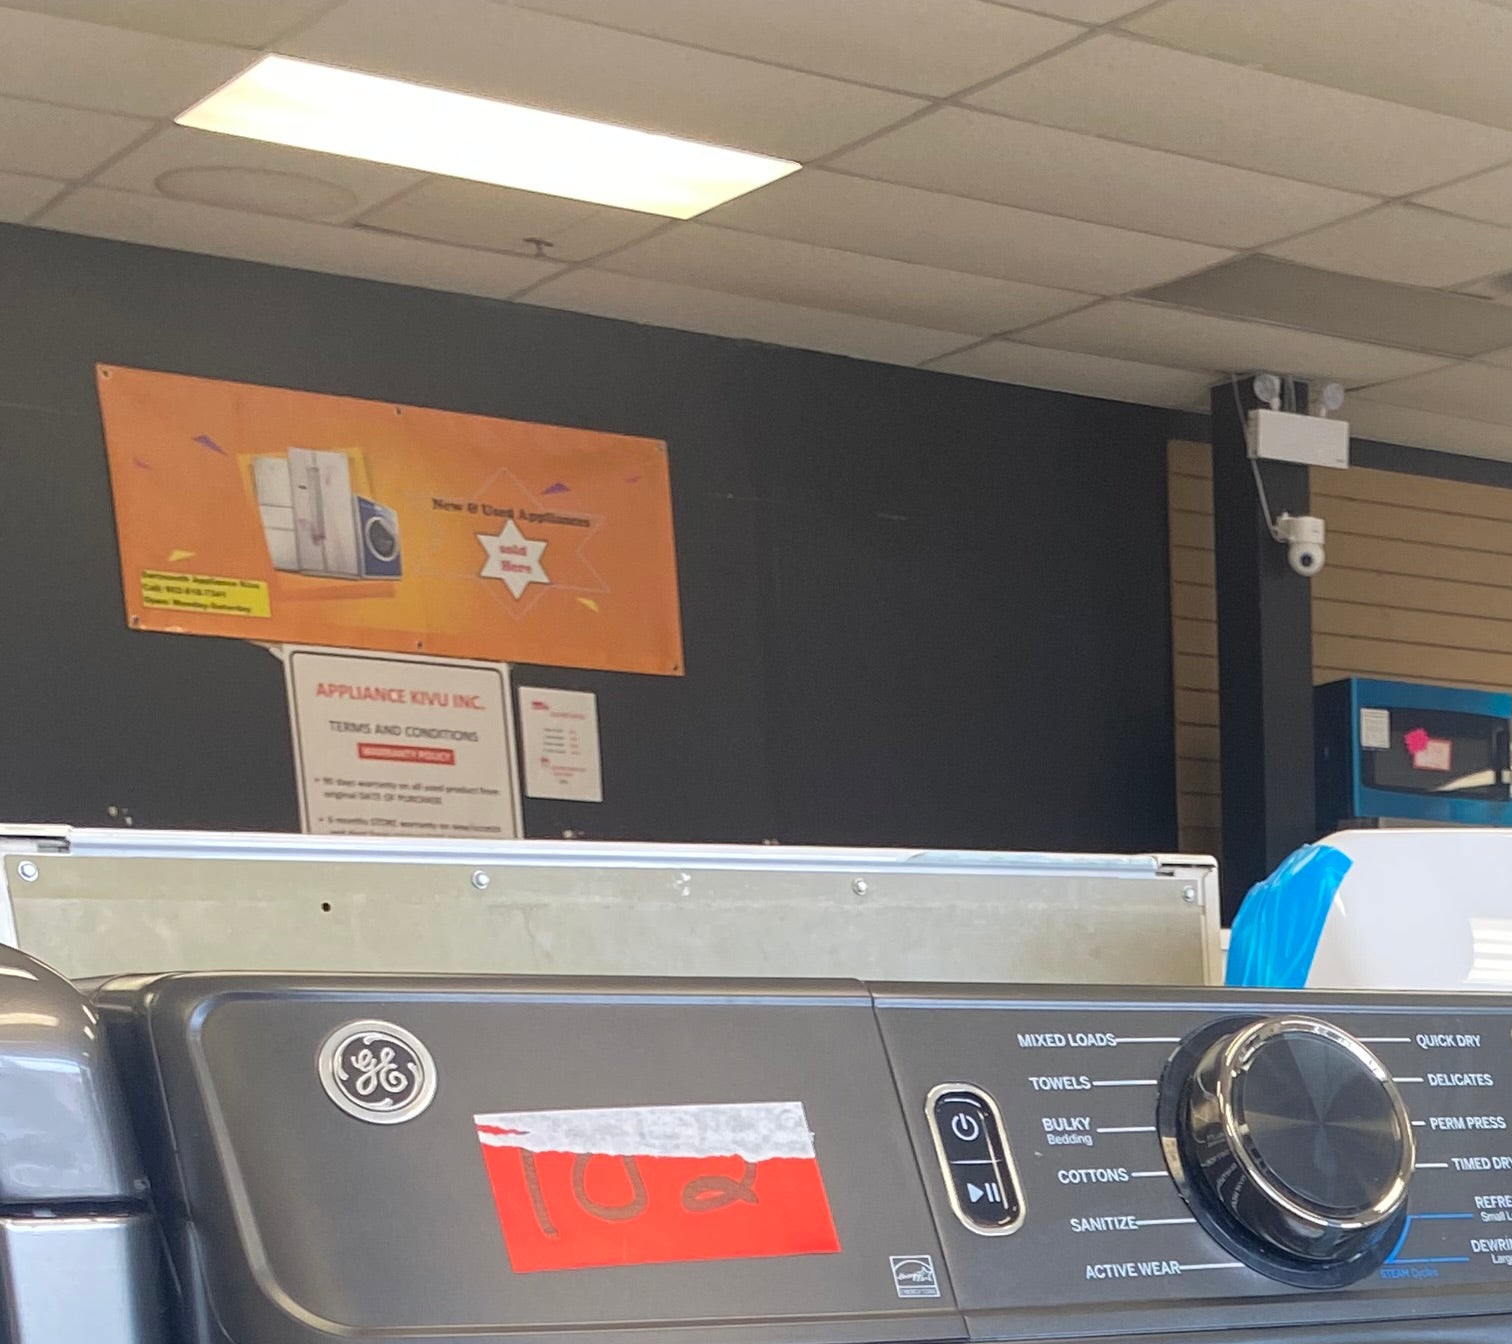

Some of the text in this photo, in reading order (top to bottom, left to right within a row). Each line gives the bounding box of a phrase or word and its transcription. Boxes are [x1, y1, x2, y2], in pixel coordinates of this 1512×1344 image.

[316, 683, 486, 710] APPLIANCE KIVU INC.
[329, 720, 479, 742] TERMS AND CONDITIONS
[1017, 1033, 1118, 1048] MIXED LOADS
[1415, 1034, 1481, 1050] QUICK DRY
[1028, 1076, 1092, 1090] TOWELS
[1427, 1073, 1494, 1086] DELICATES
[1041, 1117, 1091, 1132] BULKY
[1429, 1116, 1507, 1131] PERM PRESS
[1047, 1133, 1093, 1146] Bedding
[1451, 1157, 1492, 1171] TIMED
[1057, 1167, 1130, 1185] COTTONS
[1069, 1216, 1139, 1233] SANITIZE
[1480, 1211, 1506, 1223] Small
[1085, 1260, 1181, 1280] ACTIVE WEAR
